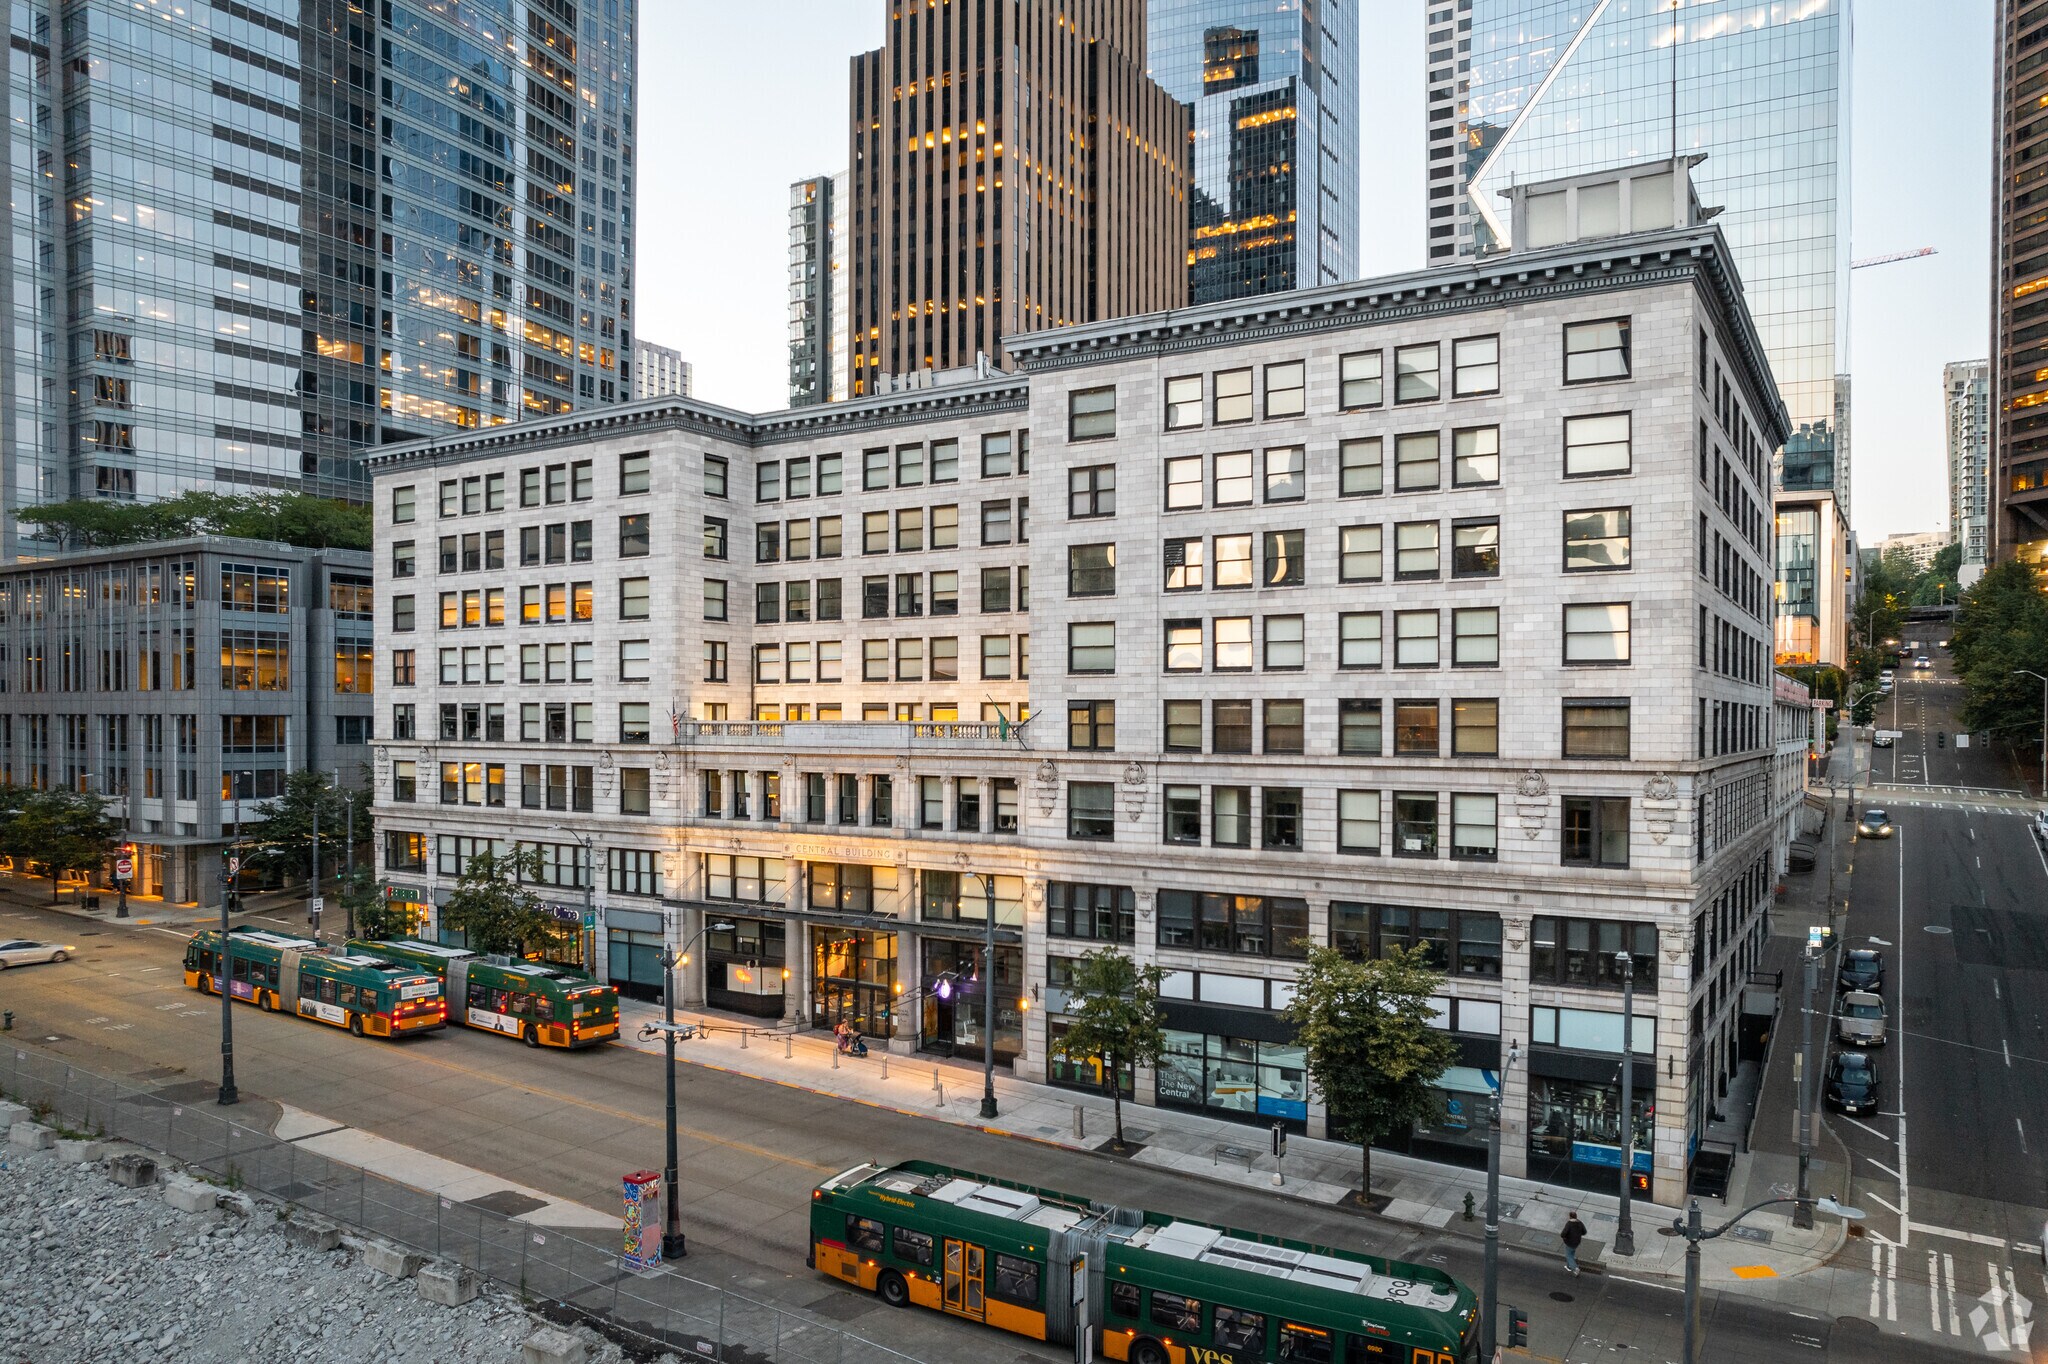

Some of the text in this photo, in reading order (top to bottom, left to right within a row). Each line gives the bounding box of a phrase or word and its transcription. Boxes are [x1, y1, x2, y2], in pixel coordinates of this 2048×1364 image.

[796, 844, 890, 858] CENTRAL BUILDING
[1160, 1070, 1185, 1082] This is
[1160, 1078, 1196, 1091] The New
[1159, 1086, 1190, 1098] Central
[1640, 1177, 1648, 1189] 5
